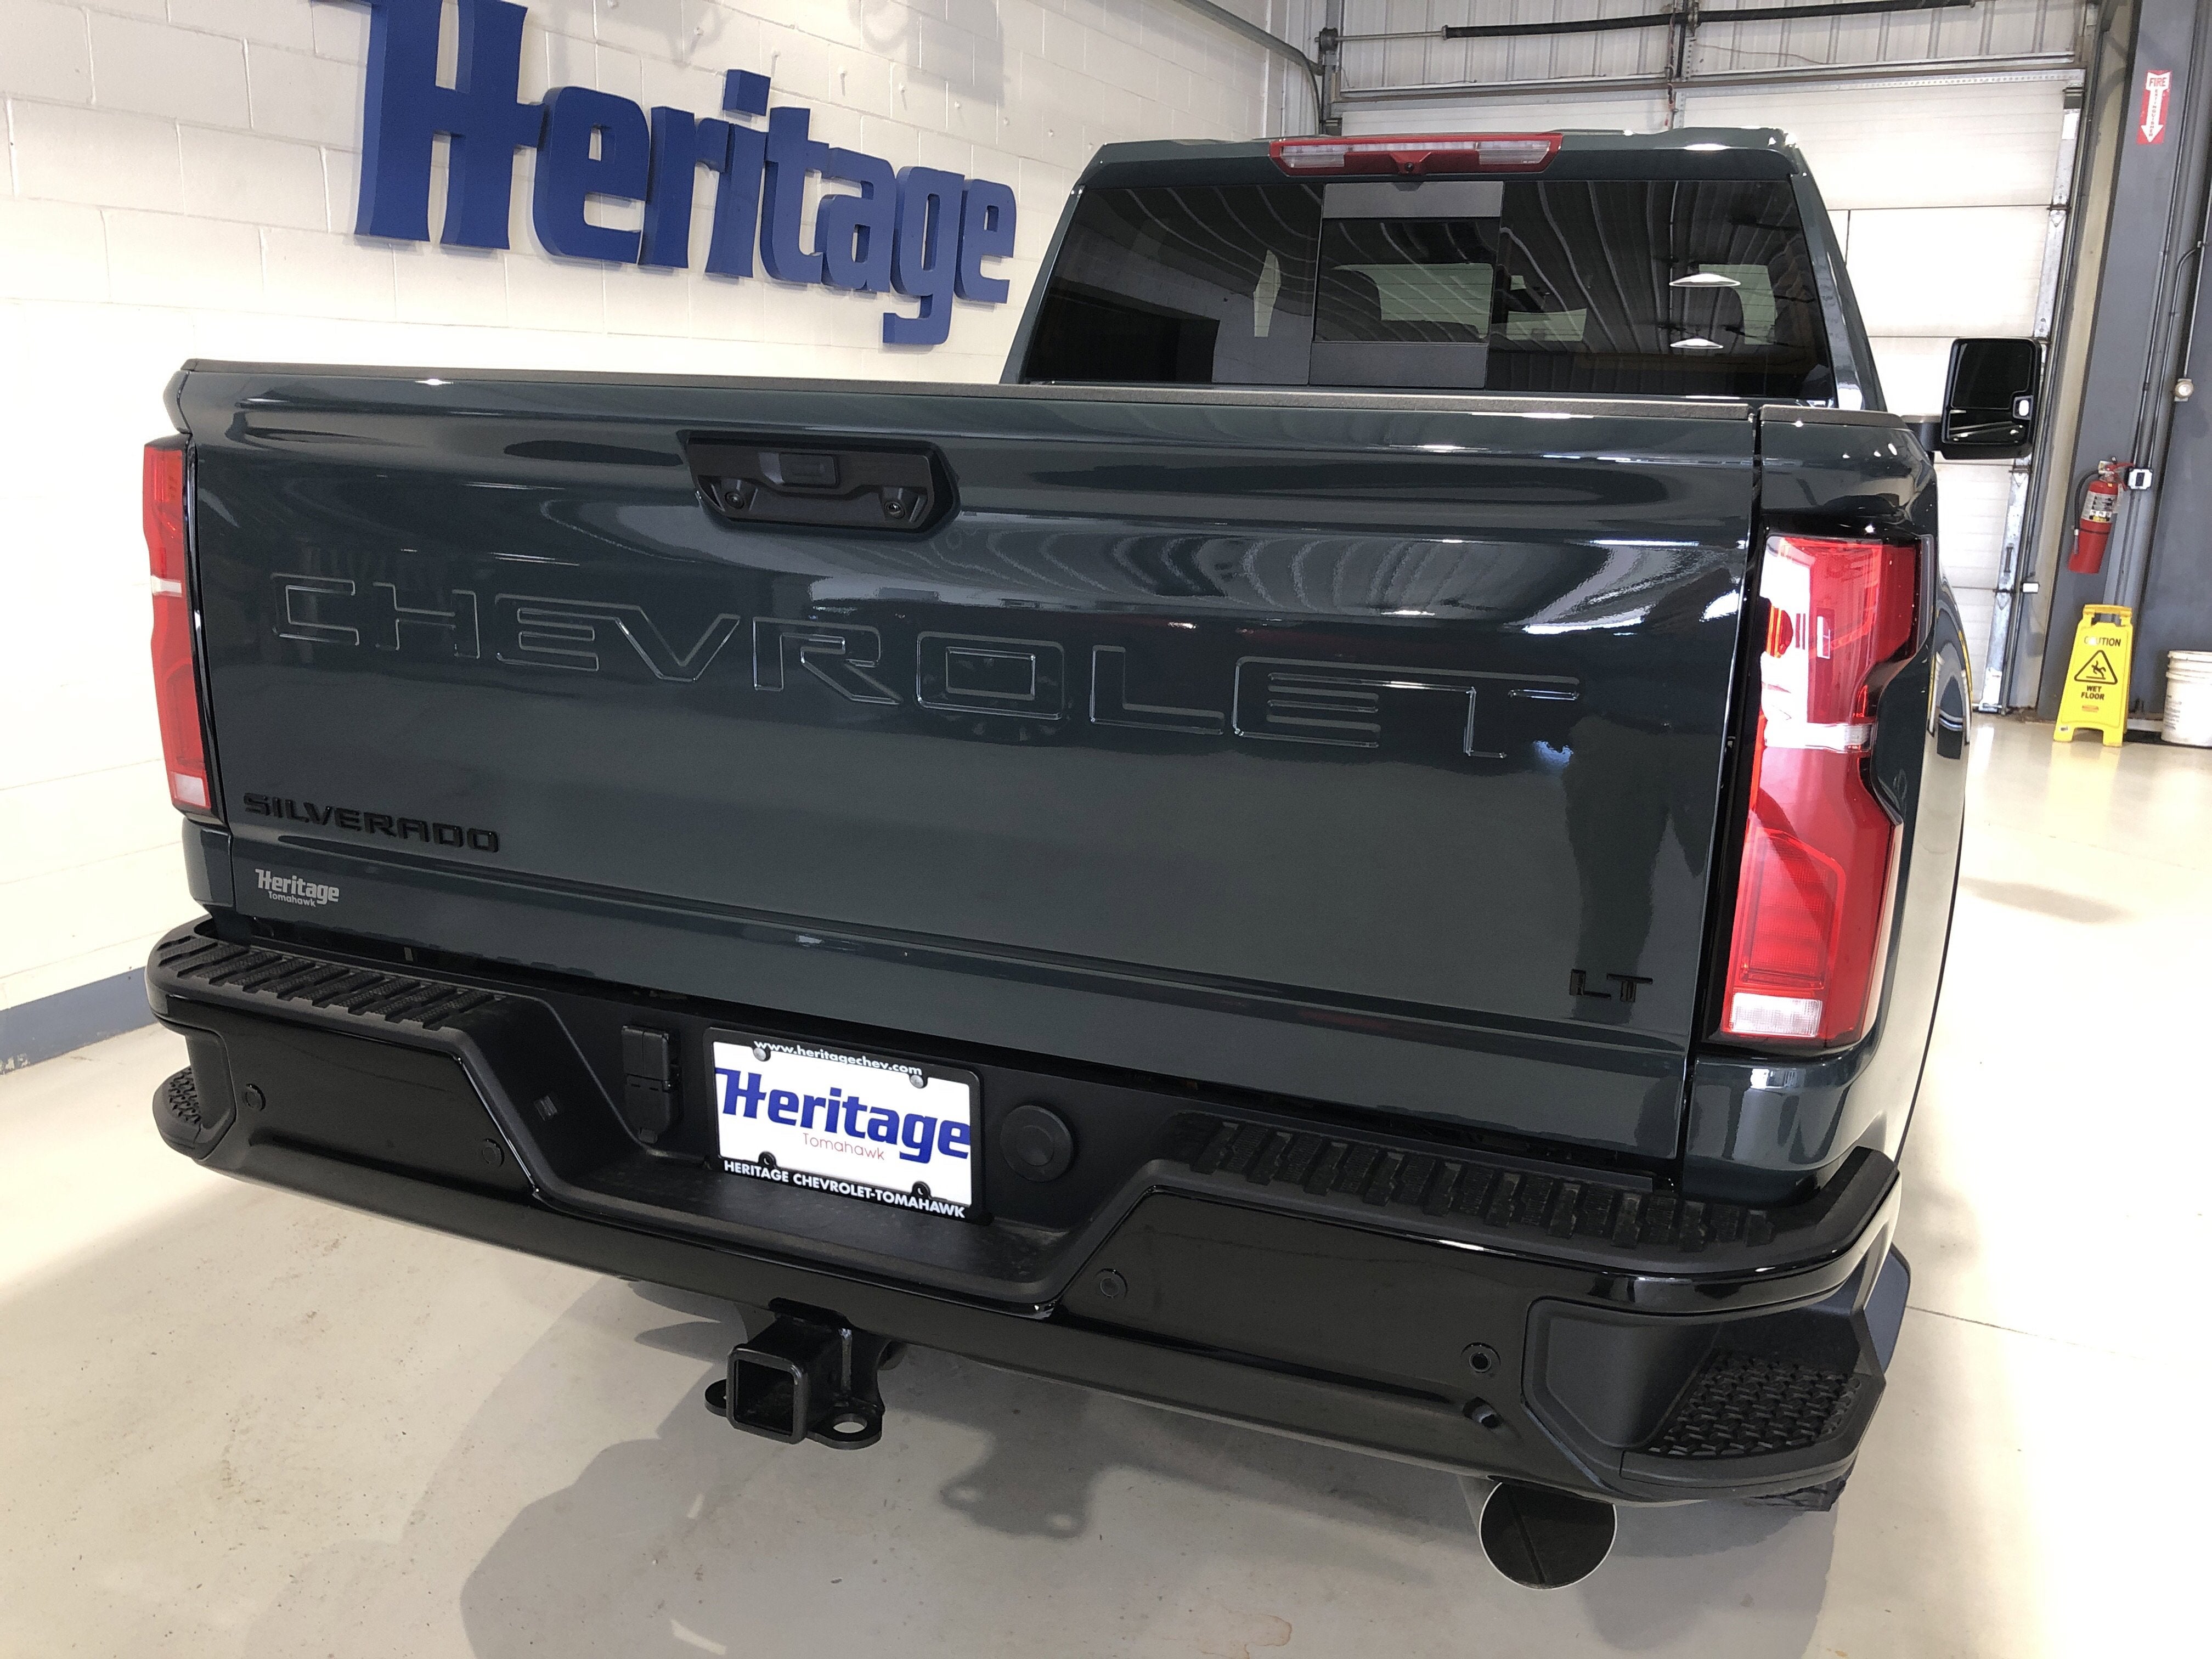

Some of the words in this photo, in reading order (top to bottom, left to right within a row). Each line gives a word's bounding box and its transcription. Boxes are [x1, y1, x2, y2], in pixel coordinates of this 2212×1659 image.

[2149, 77, 2167, 87] FIRE
[312, 0, 1017, 345] Heritage
[2084, 636, 2121, 647] CUTION
[271, 572, 1581, 759] CHEVROLET
[2081, 692, 2104, 700] FLOOR
[243, 792, 500, 853] SILVERADO
[255, 868, 340, 904] Heritage
[268, 890, 317, 907] Tomahawk
[1570, 968, 1654, 1002] LT
[754, 1041, 922, 1075] www.heritagechev.com
[715, 1067, 970, 1164] Heritage
[803, 1132, 885, 1161] Tomahawk
[724, 1160, 789, 1183] HERITAGE
[793, 1173, 966, 1219] CHEVROLET-TOMAHAWK
